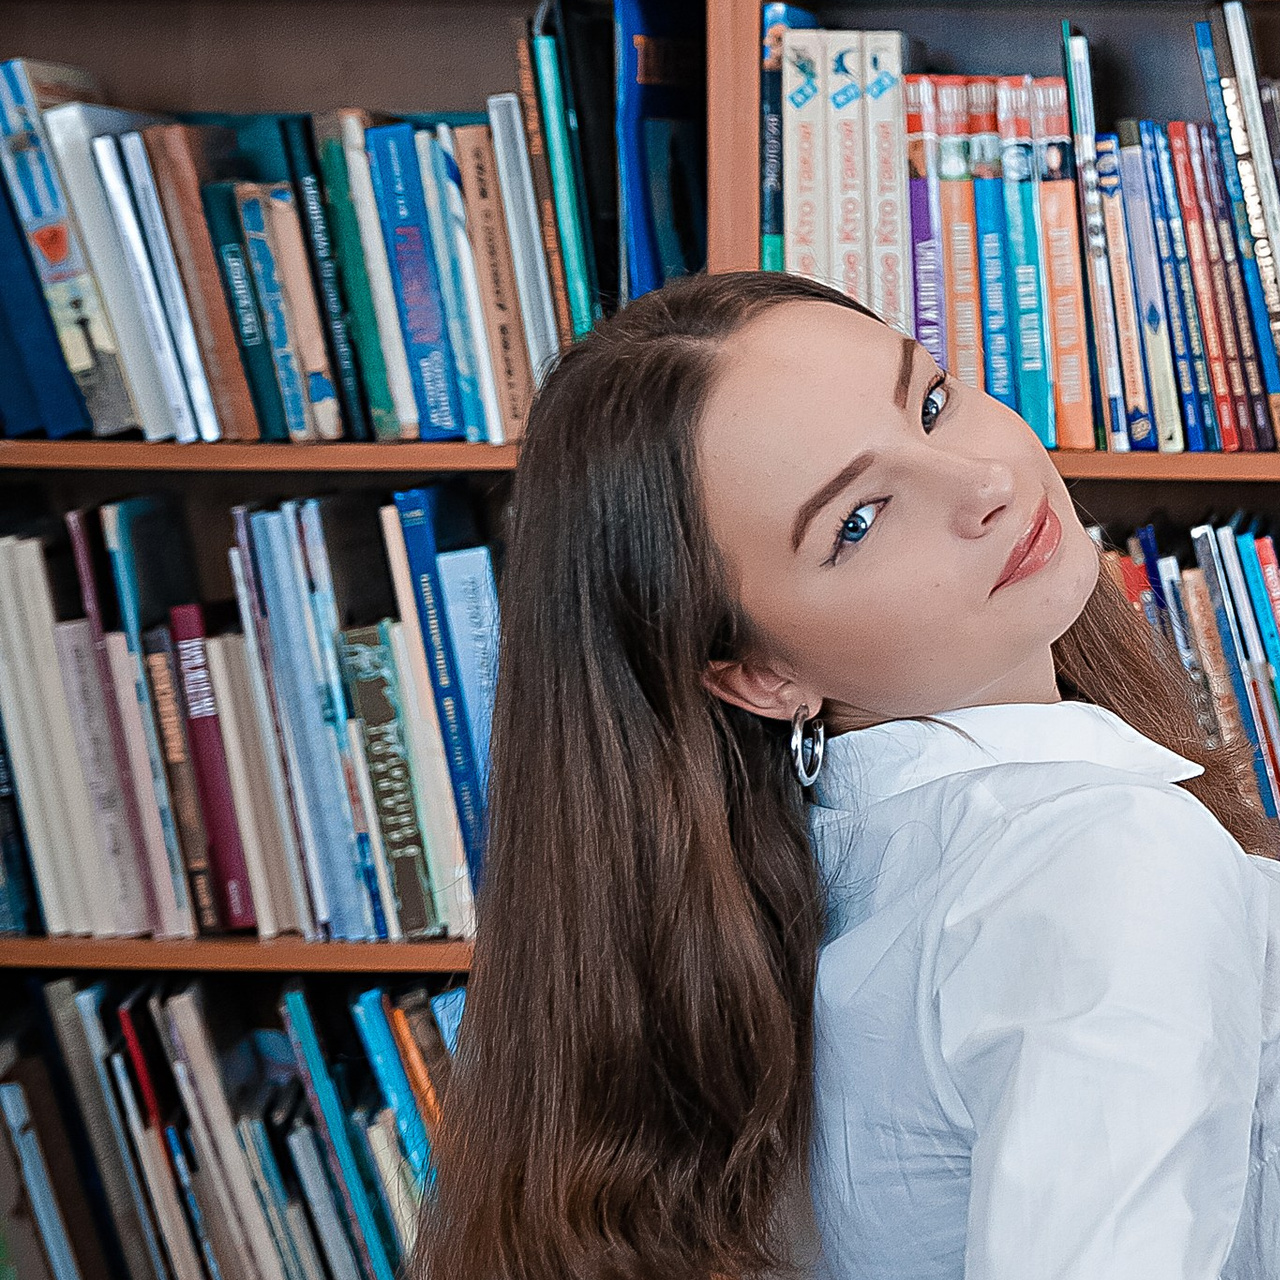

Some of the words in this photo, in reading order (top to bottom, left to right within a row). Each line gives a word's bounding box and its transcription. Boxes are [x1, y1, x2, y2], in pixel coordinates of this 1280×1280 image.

[794, 123, 815, 194] такой
[837, 120, 858, 192] такой
[874, 122, 895, 194] такой
[795, 201, 815, 245] Кто
[839, 197, 860, 243] Кто
[876, 201, 897, 245] Кто
